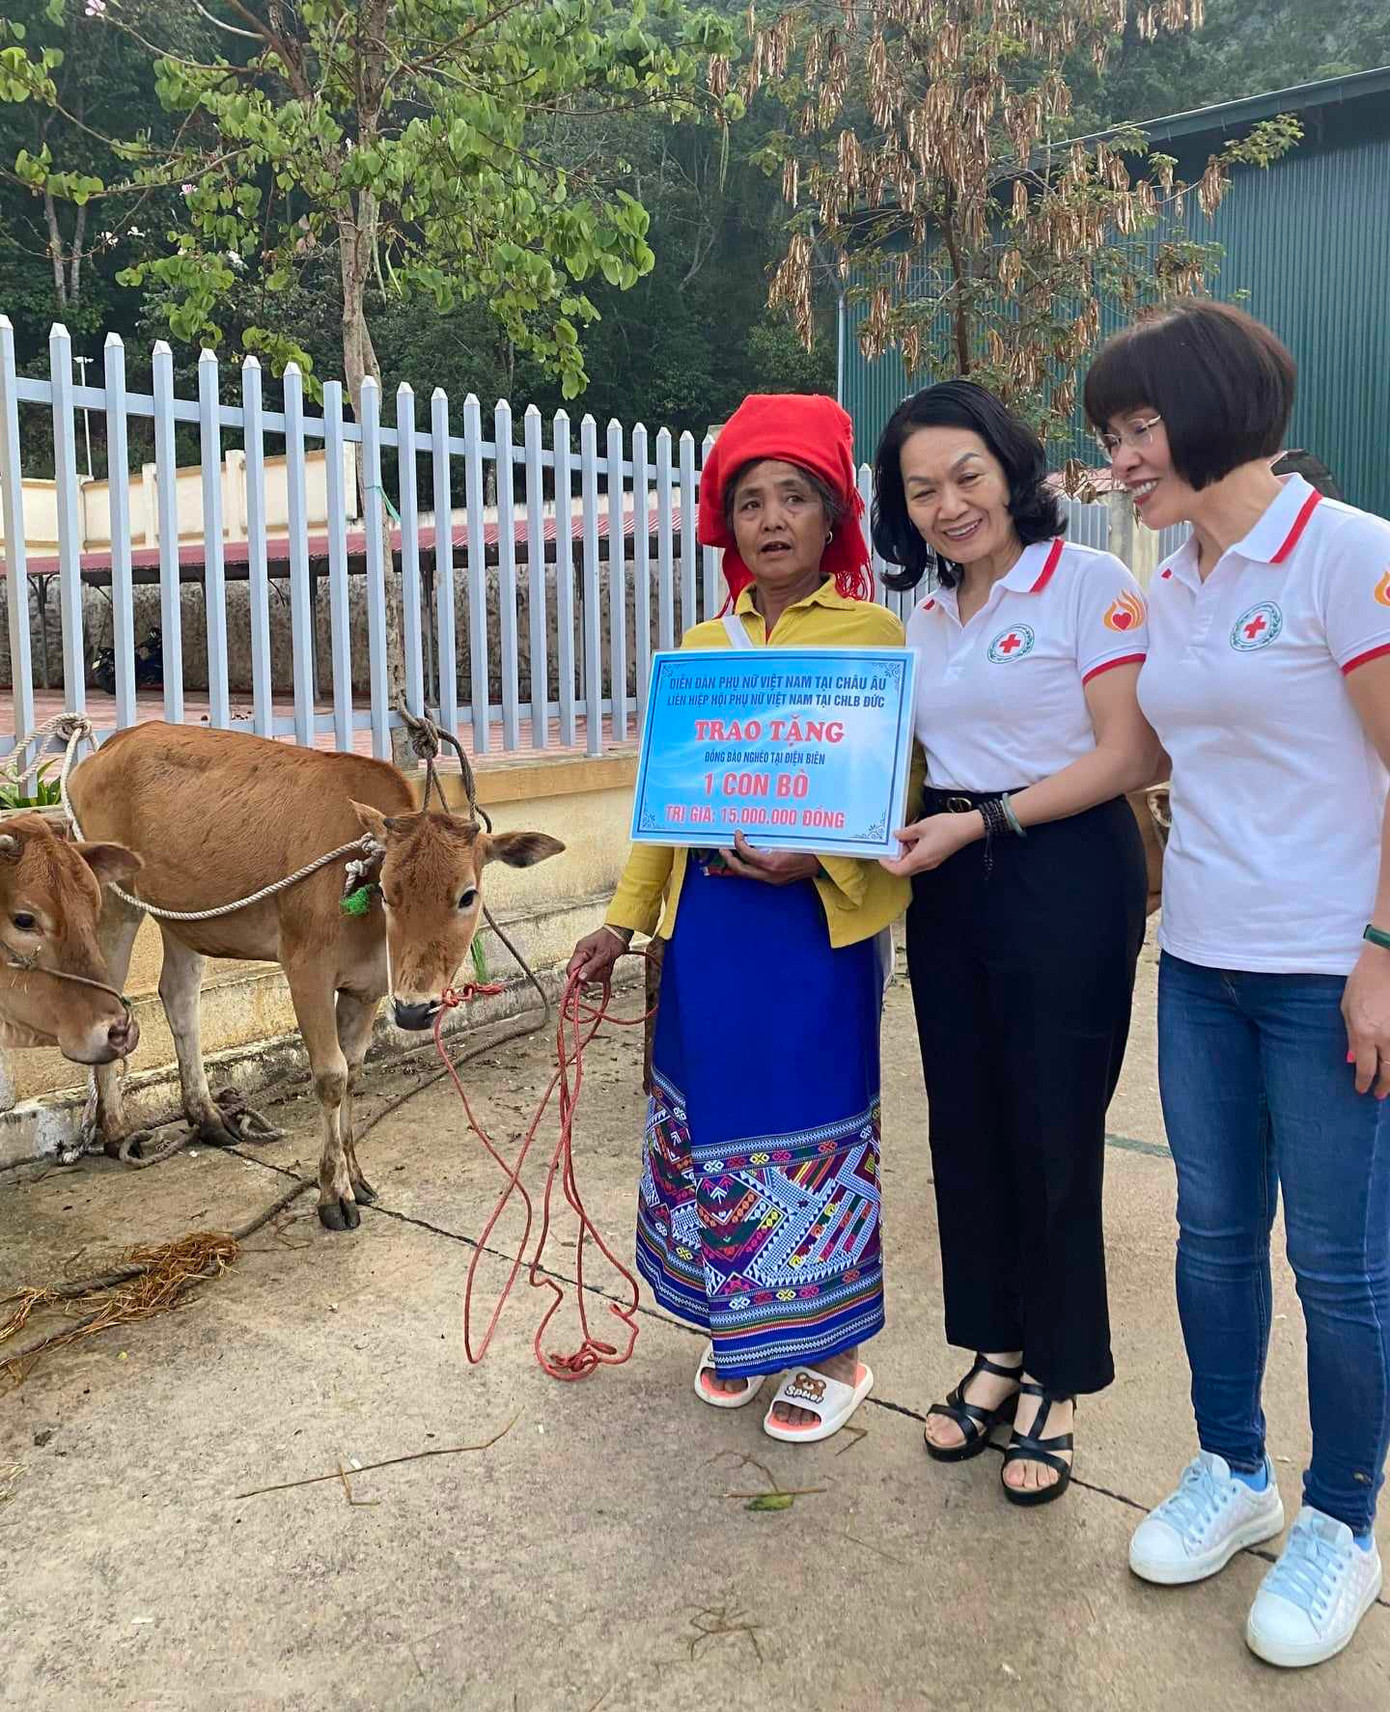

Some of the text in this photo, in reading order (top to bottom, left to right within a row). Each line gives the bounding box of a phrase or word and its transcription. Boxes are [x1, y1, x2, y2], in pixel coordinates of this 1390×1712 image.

[718, 676, 739, 691] PHỤ
[742, 674, 760, 689] NỮ
[761, 673, 785, 691] VIỆT
[785, 675, 812, 689] NAM
[815, 676, 833, 691] TẠI
[836, 675, 867, 690] CHÂU
[870, 675, 887, 691] ÂU
[667, 692, 885, 708] LIÊN HIỆP HỘI PHỤ NỮ VIỆT NAM TẠI CHLB ĐỨC
[694, 713, 845, 747] TRAO TẶNG
[727, 750, 742, 763] BÀO
[743, 750, 769, 763] NGHÈO
[771, 752, 784, 766] TẠI
[805, 751, 826, 765] BIÊN
[704, 768, 809, 798] 1 CON BÒ
[666, 804, 845, 829] TRỊ GIÁ: 15.000.000 ĐỒNG
